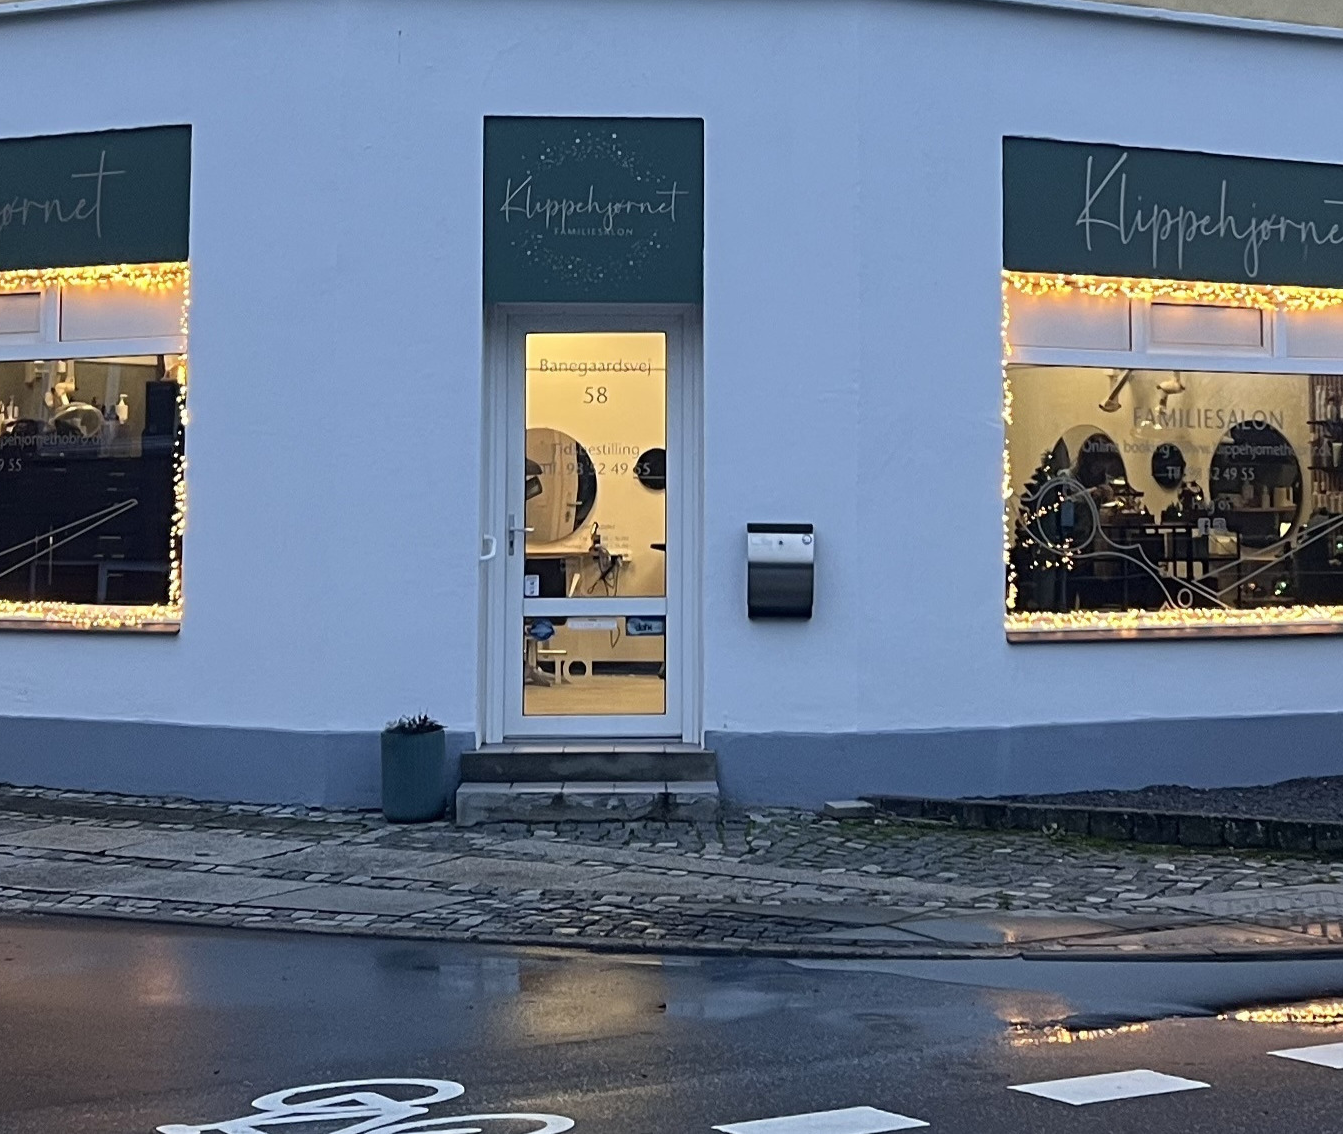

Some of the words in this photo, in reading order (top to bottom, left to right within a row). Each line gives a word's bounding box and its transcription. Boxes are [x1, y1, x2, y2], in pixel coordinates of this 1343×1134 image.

[500, 176, 689, 231] Klippehjørnet
[553, 227, 634, 237] FAMILIESALON
[539, 359, 652, 376] Banegaardsvej
[583, 386, 608, 404] 58
[1133, 407, 1284, 430] FAMILIESALON
[7, 458, 22, 472] 55
[611, 462, 629, 475] 49
[1223, 467, 1237, 480] 49
[1240, 467, 1255, 480] 55
